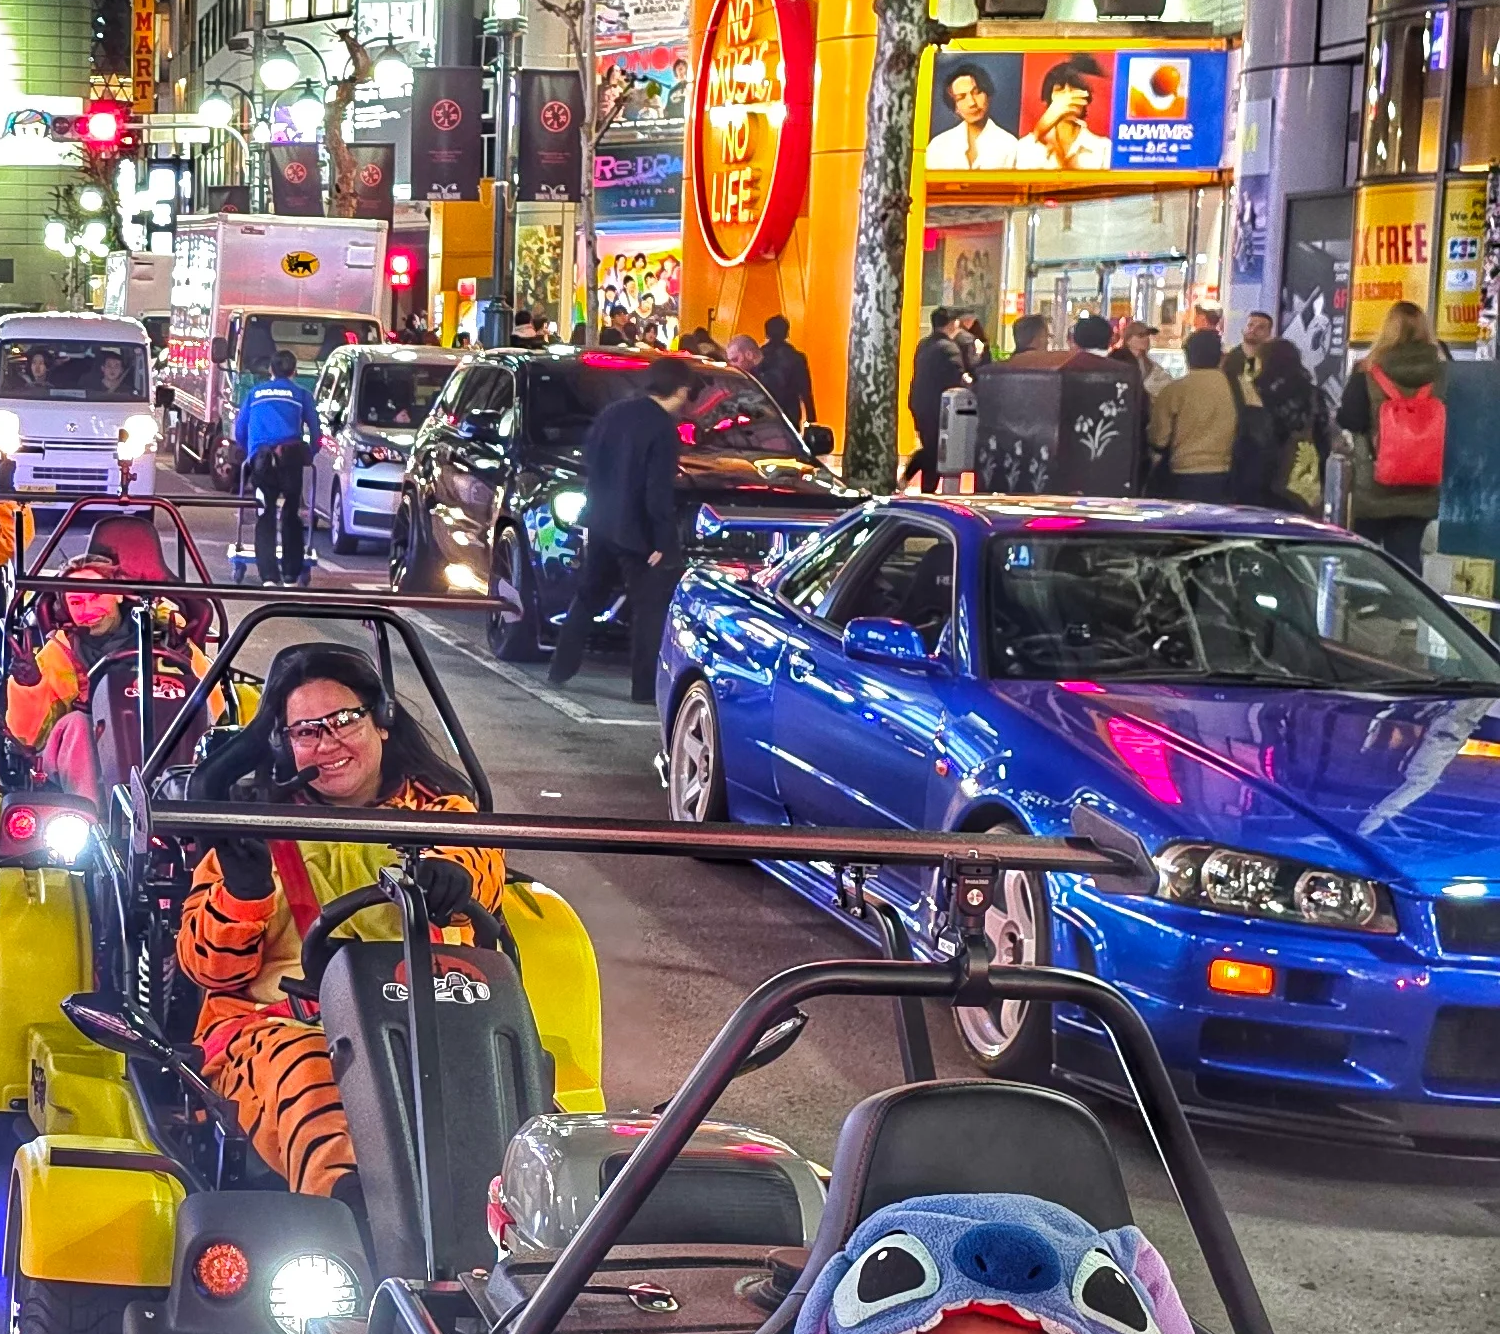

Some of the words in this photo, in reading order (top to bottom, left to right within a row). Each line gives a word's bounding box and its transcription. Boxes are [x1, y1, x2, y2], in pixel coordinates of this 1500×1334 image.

[722, 114, 749, 163] NO
[1118, 124, 1194, 140] RADWIMPS
[1375, 222, 1428, 266] FREE
